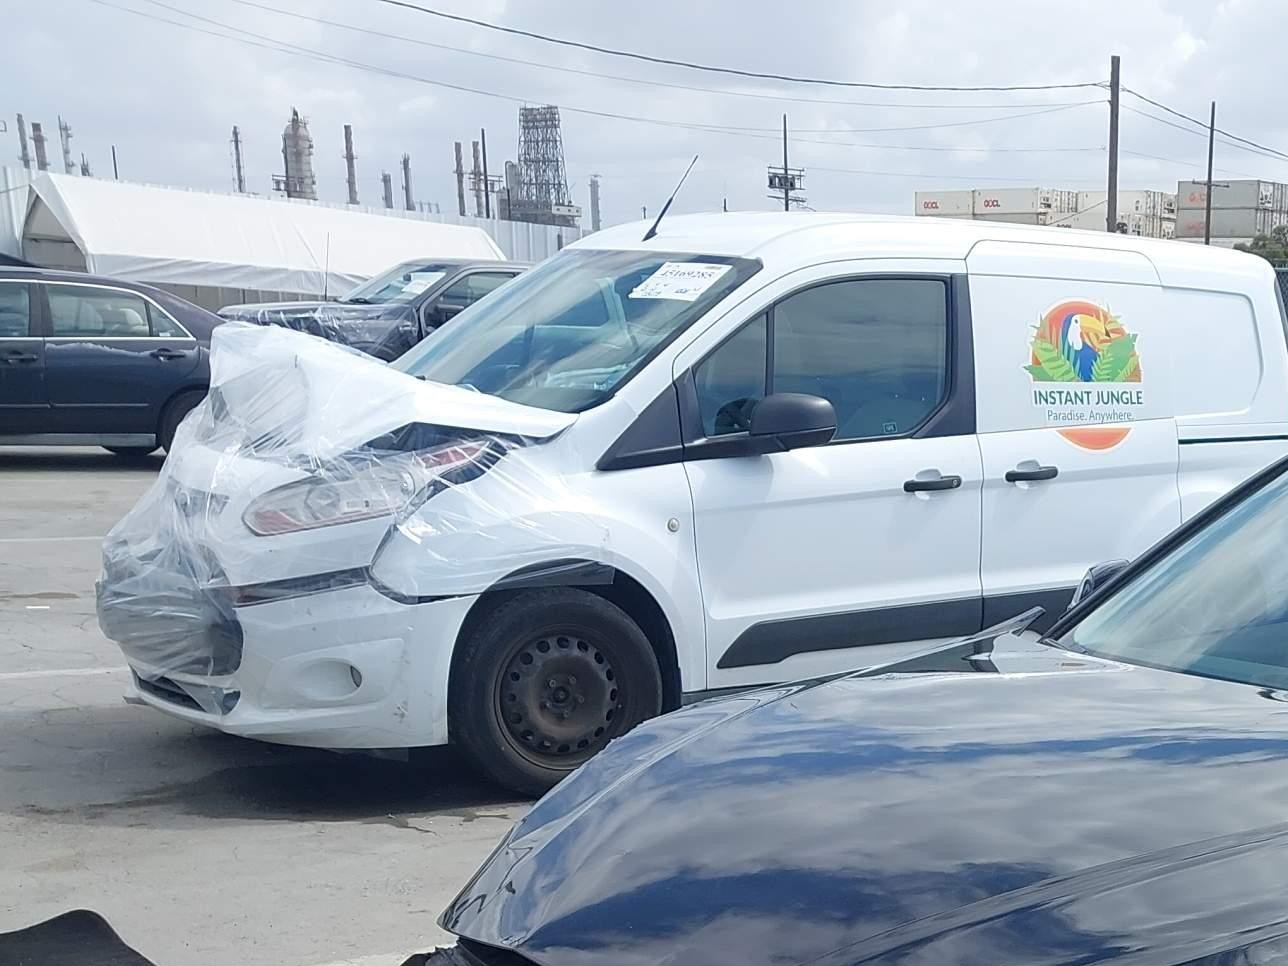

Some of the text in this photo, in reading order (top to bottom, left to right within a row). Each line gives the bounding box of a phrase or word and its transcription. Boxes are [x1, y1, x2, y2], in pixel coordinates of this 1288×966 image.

[1033, 390, 1144, 405] INSTANT JUNGLE
[1047, 409, 1135, 424] Paradise. Anywhere.
